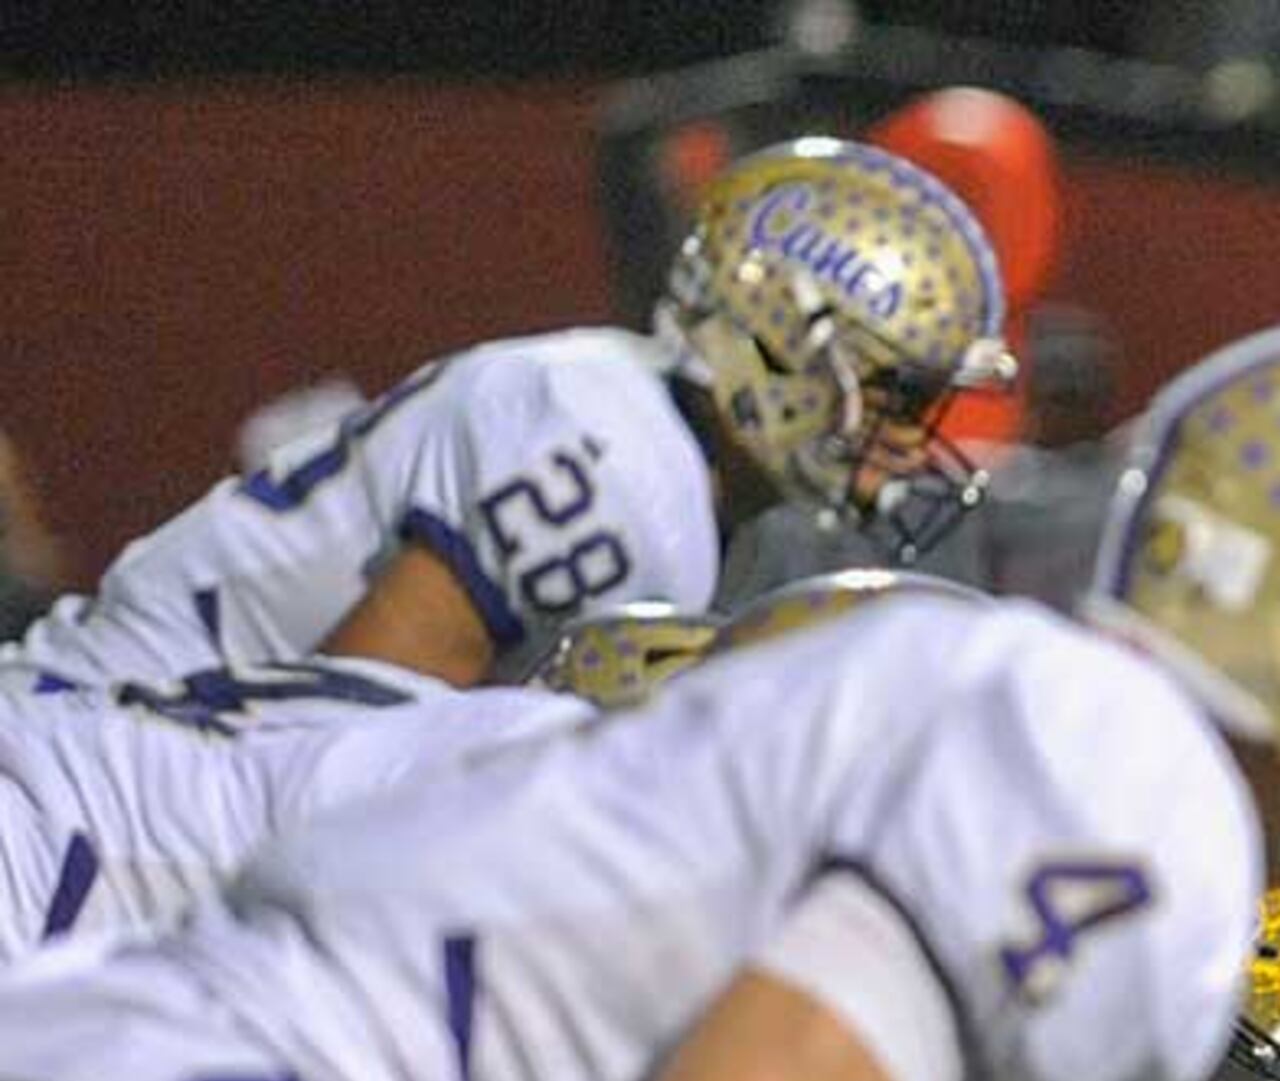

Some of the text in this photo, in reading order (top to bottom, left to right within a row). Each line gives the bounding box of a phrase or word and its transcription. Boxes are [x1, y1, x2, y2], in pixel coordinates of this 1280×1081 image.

[750, 185, 899, 314] Canes
[478, 450, 633, 615] 28
[1001, 863, 1156, 1003] 4
